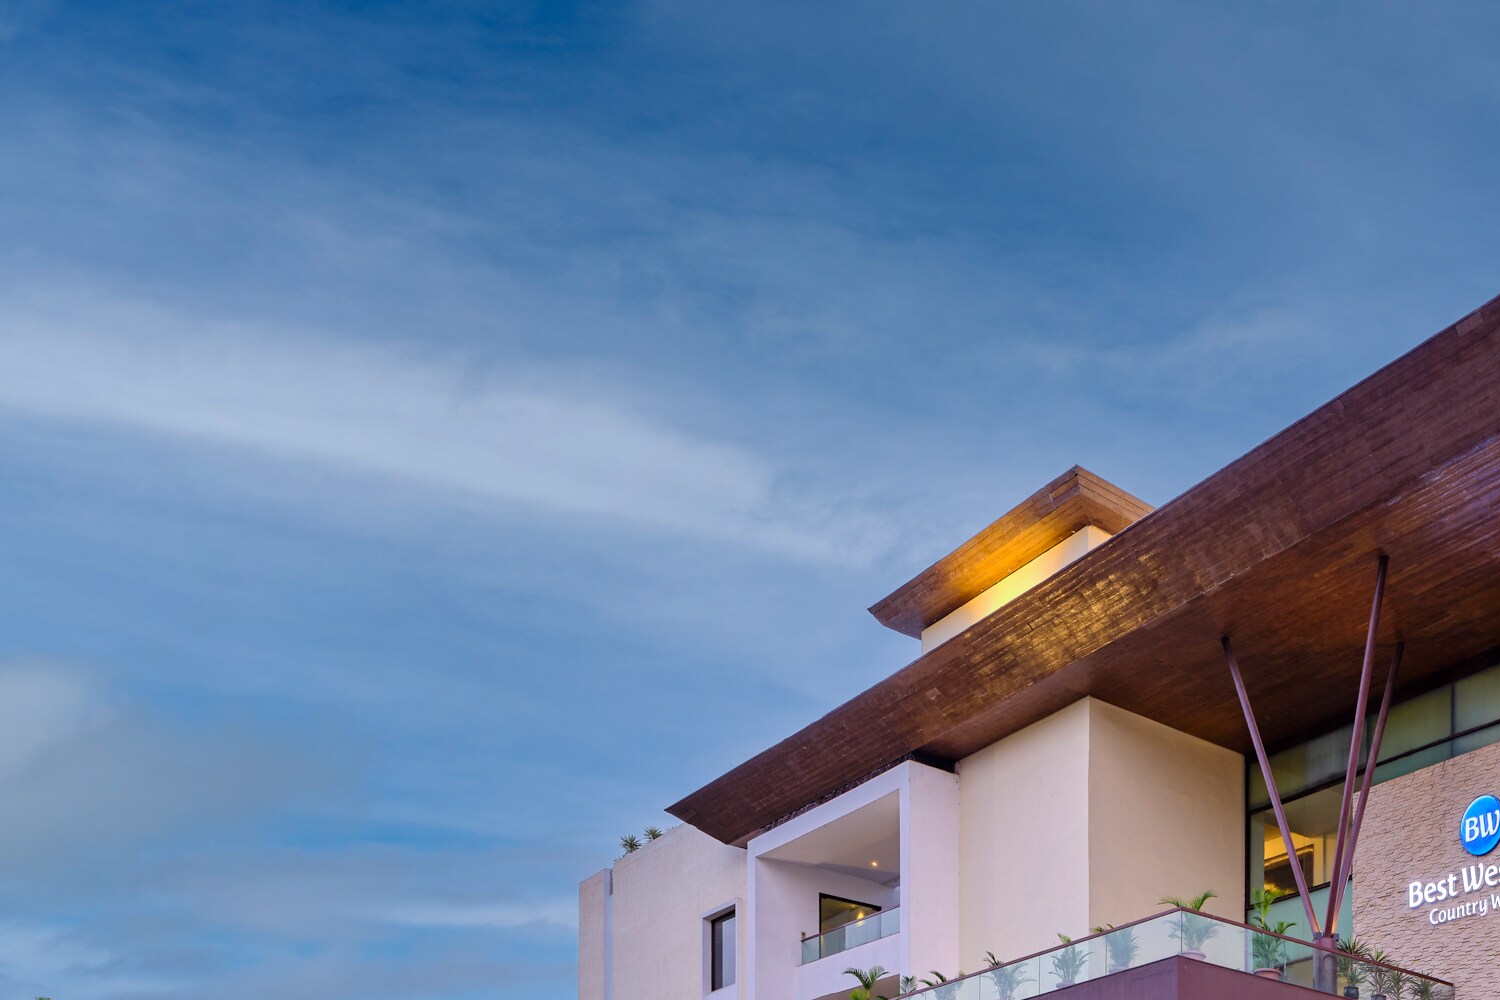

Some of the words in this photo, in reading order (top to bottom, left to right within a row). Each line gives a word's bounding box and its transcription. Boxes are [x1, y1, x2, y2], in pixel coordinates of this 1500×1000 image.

[1465, 809, 1500, 843] BW
[1408, 873, 1458, 908] Best
[1429, 898, 1488, 925] Country
